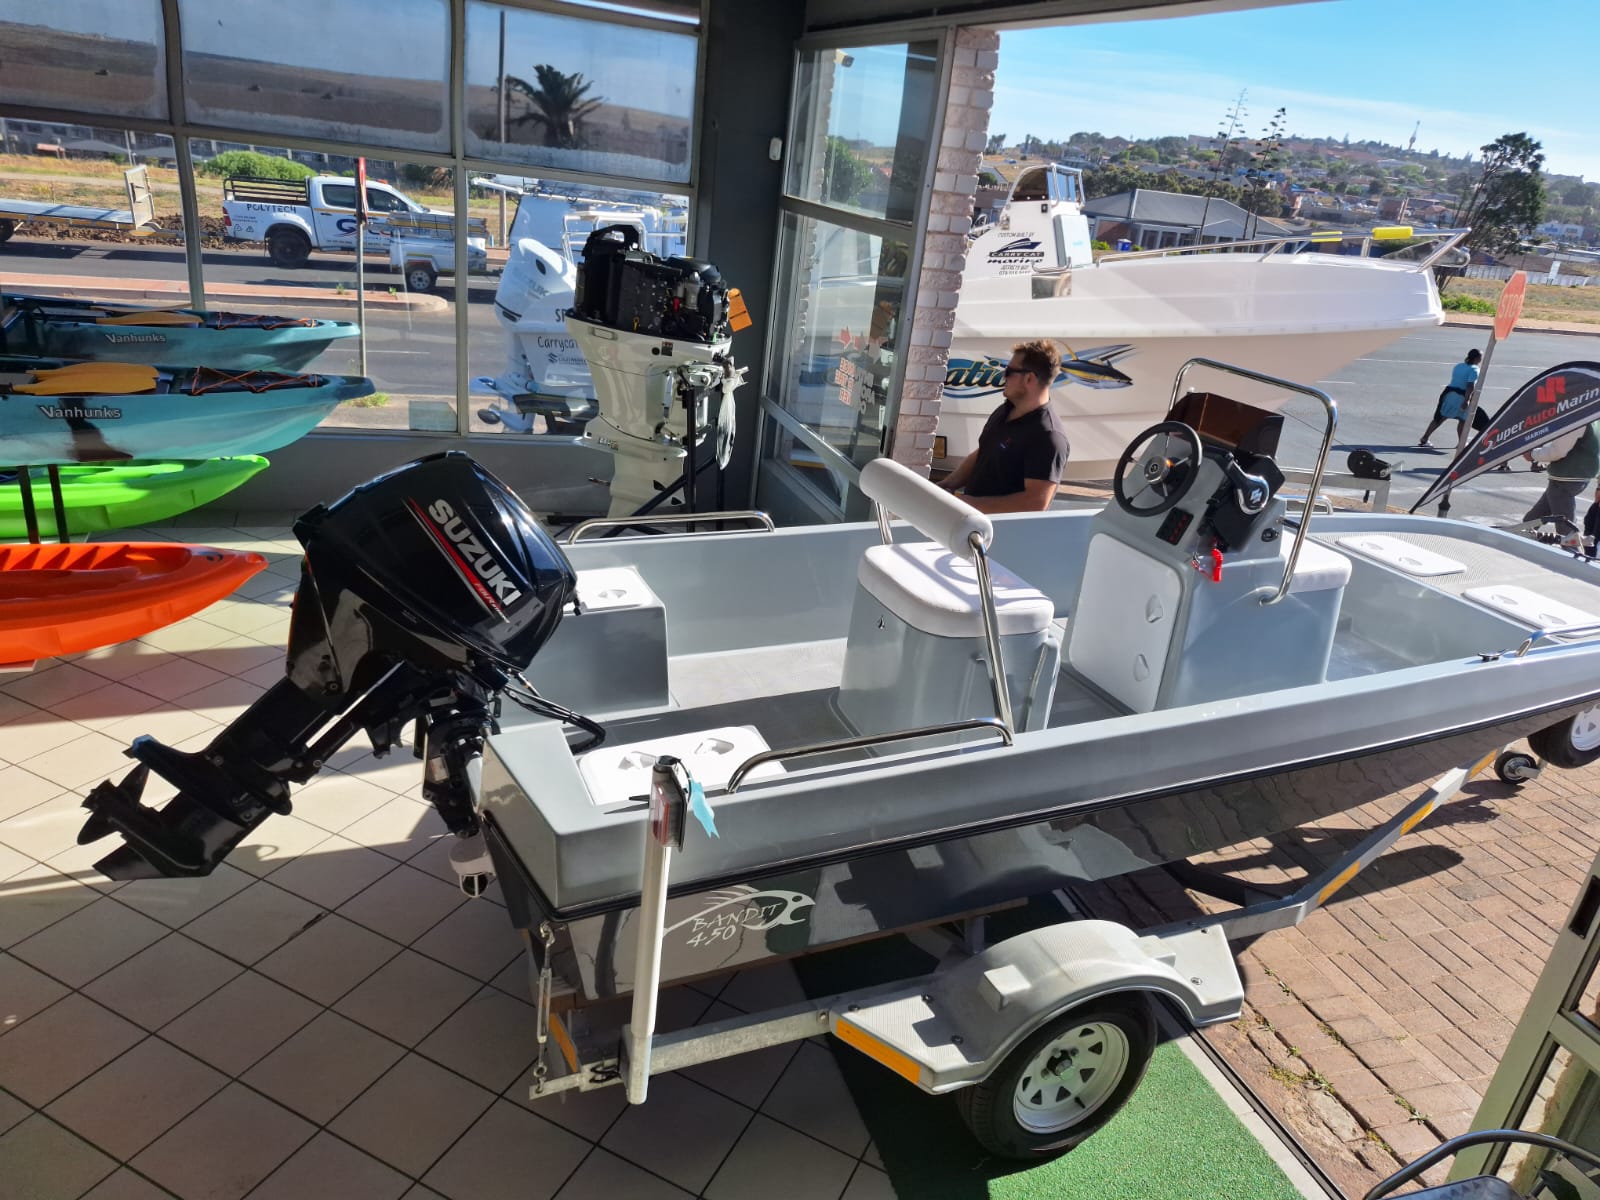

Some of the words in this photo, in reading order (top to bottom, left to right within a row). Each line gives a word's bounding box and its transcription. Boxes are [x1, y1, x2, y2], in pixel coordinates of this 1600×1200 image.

[246, 203, 297, 214] POLYTECH
[104, 333, 167, 344] Vanhunks
[39, 405, 122, 419] Vanhunks
[428, 499, 522, 606] SUZUKI
[692, 902, 783, 933] BANDIT
[686, 924, 738, 948] 450
